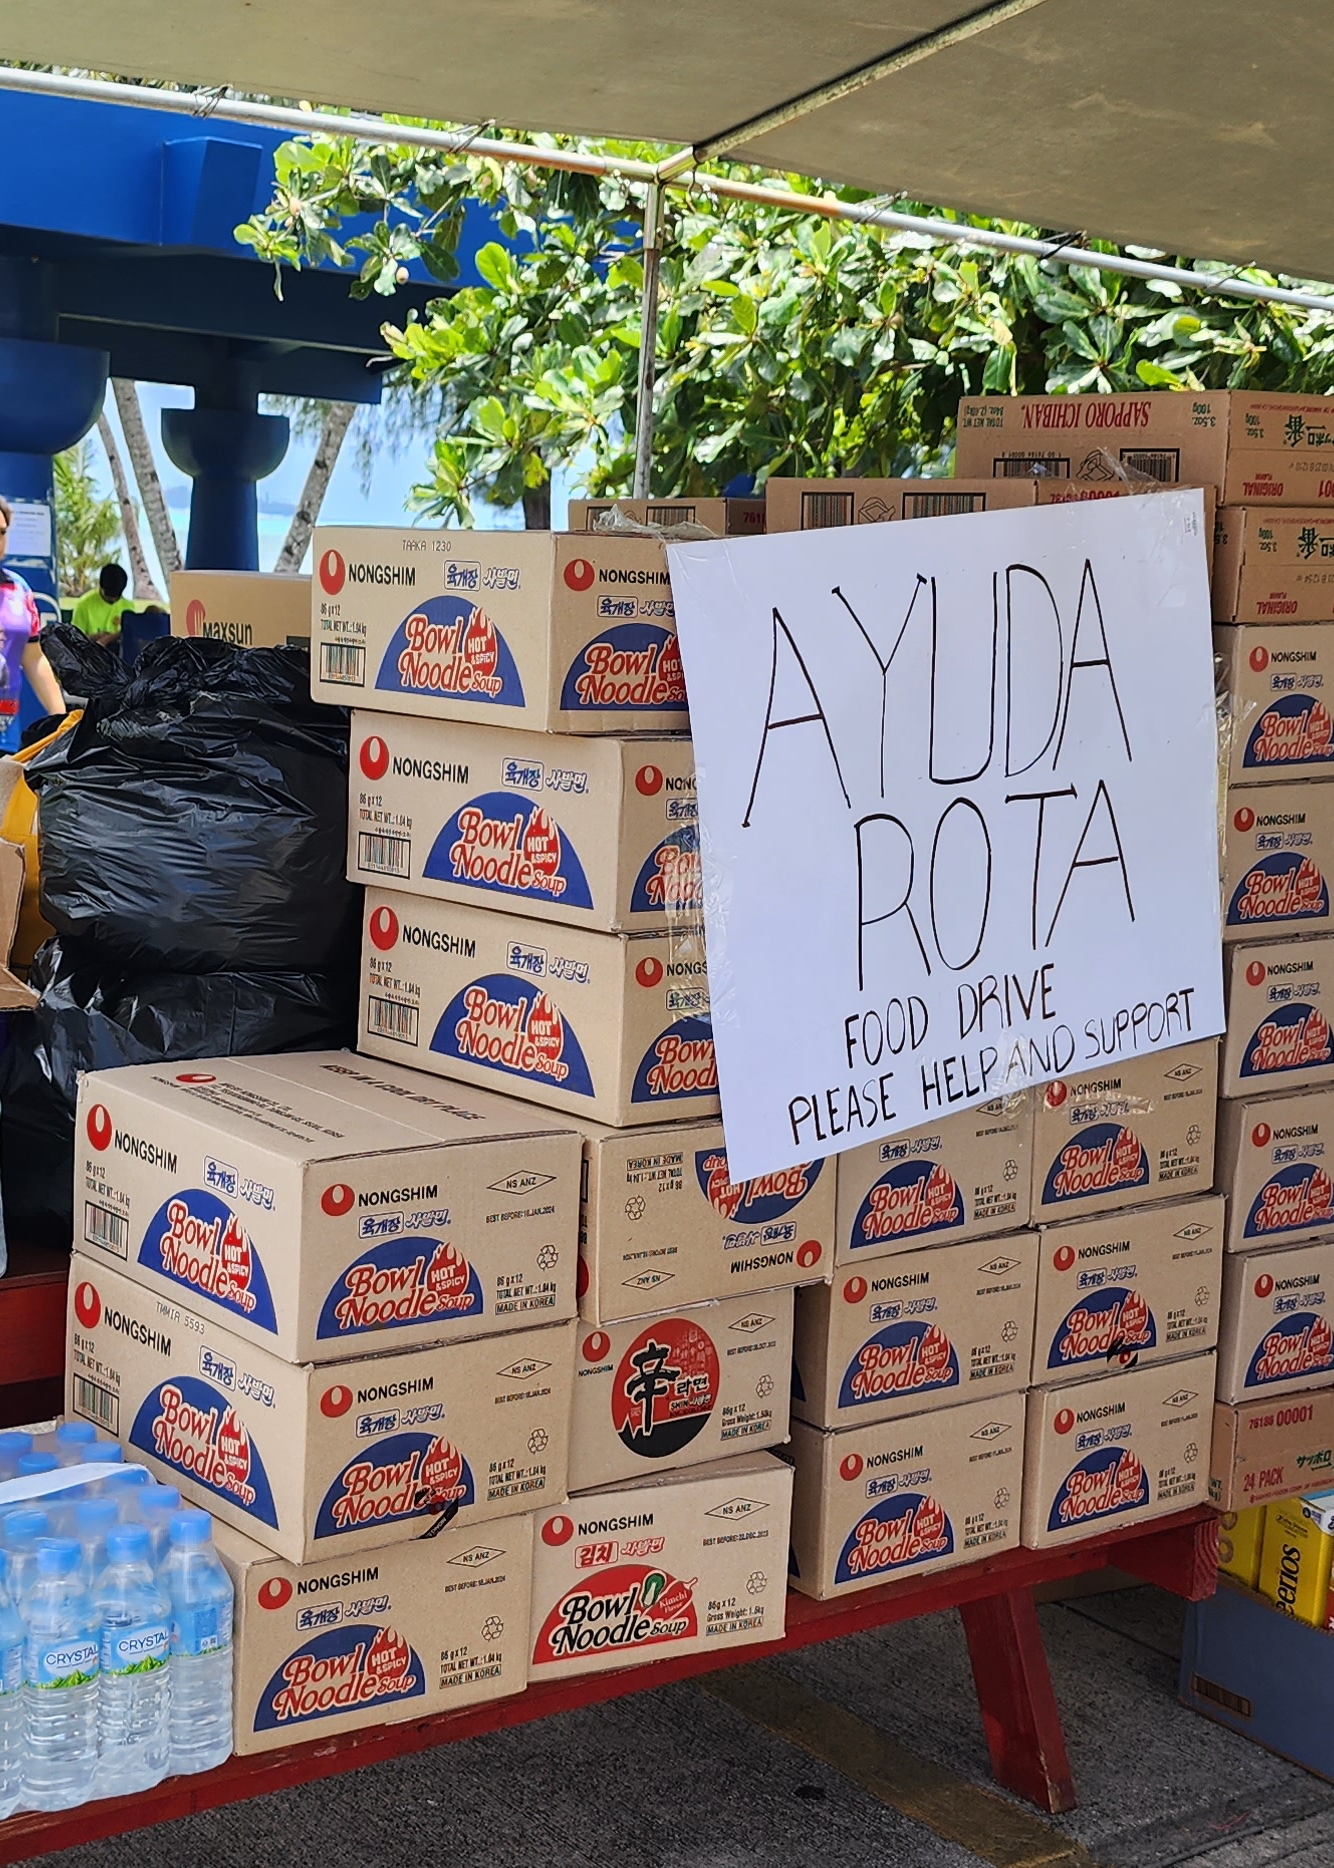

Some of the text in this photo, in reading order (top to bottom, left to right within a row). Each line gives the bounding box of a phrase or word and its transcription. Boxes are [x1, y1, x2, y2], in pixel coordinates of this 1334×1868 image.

[1085, 401, 1152, 428] SAPPORO
[1242, 482, 1283, 498] ORIGINAL
[431, 540, 452, 552] 1230
[348, 563, 416, 587] NONGSHIM
[598, 568, 670, 585] NONGSHIM
[1256, 601, 1298, 615] ORIGINAL
[405, 614, 463, 653] Bowl
[467, 638, 488, 652] HOT
[585, 643, 656, 678] Bowl
[1271, 650, 1317, 663] NONGSHIM
[398, 652, 472, 691] Noodle
[471, 673, 502, 697] Soup
[576, 675, 667, 704] Noodle
[742, 558, 1133, 828] AYUDA
[1261, 709, 1307, 740] Bowl
[1254, 736, 1312, 762] Noodle
[392, 757, 469, 784] NONGSHIM
[458, 806, 522, 852] Bowl
[1256, 813, 1306, 827] NONGSHIM
[450, 842, 532, 889] Noodle
[854, 779, 1136, 991] ROTA
[402, 924, 476, 959] NONGSHIM
[1267, 961, 1314, 976] NONGSHIM
[464, 987, 527, 1034] Bowl
[845, 963, 1056, 1069] FOOD DRIVE
[454, 1024, 537, 1072] Noodle
[789, 988, 1195, 1145] PLEASE HELP AND SUPPORT
[1070, 1077, 1122, 1097] NONGSHIM
[1272, 1123, 1319, 1141] NONGSHIM
[114, 1129, 178, 1175] NONGSHIM
[506, 1176, 537, 1189] NS ANZ
[357, 1184, 439, 1208] NONGSHIM
[730, 1250, 794, 1274] NONGSHIM
[1077, 1240, 1130, 1259] NONGSHIM
[346, 1256, 425, 1302] Bowl
[430, 1263, 456, 1284] HOT
[871, 1272, 930, 1293] NONGSHIM
[1275, 1273, 1320, 1292] NONGSHIM
[336, 1289, 436, 1331] Noodle
[434, 1291, 475, 1315] Soup
[497, 1301, 518, 1313] MADE
[529, 1296, 554, 1308] KOREA
[104, 1308, 171, 1357] NONGSHIM
[183, 1313, 205, 1335] 5593
[1068, 1308, 1119, 1339] Bowl
[860, 1338, 918, 1374] Bowl
[578, 1364, 614, 1378] NONGSHIM
[851, 1364, 925, 1399] Noodle
[357, 1377, 434, 1403] NONGSHIM
[627, 1338, 680, 1437] 辛
[675, 1376, 709, 1394] 라면
[160, 1386, 218, 1447] Bowl
[670, 1400, 688, 1411] SHIN
[1076, 1401, 1126, 1423] NONGSHIM
[1276, 1404, 1314, 1427] 00001
[153, 1418, 226, 1487] Noodle
[866, 1445, 923, 1468] NONGSHIM
[343, 1452, 421, 1497] Bowl
[1067, 1465, 1116, 1498] Bowl
[1243, 1472, 1256, 1492] 24
[1259, 1466, 1284, 1489] PACK
[722, 1503, 751, 1515] NS ANZ
[1060, 1490, 1122, 1521] Noodle
[578, 1514, 654, 1536] NONGSHIM
[857, 1511, 911, 1546] Bowl
[578, 1544, 615, 1566] 김치
[848, 1539, 921, 1574] Noodle
[297, 1567, 380, 1595] NONGSHIM
[563, 1585, 639, 1631] Bowl
[659, 1590, 688, 1609] Kimchi
[550, 1617, 651, 1657] Noodle
[650, 1618, 689, 1637] Soup
[707, 1624, 727, 1634] MADE
[738, 1618, 762, 1629] KOREA
[46, 1644, 98, 1665] CRYSTAL
[118, 1631, 169, 1652] CRYSTAL
[284, 1643, 366, 1691] Bowl
[370, 1648, 397, 1668] HOT
[375, 1673, 415, 1697] Soup
[273, 1678, 377, 1722] Noodle
